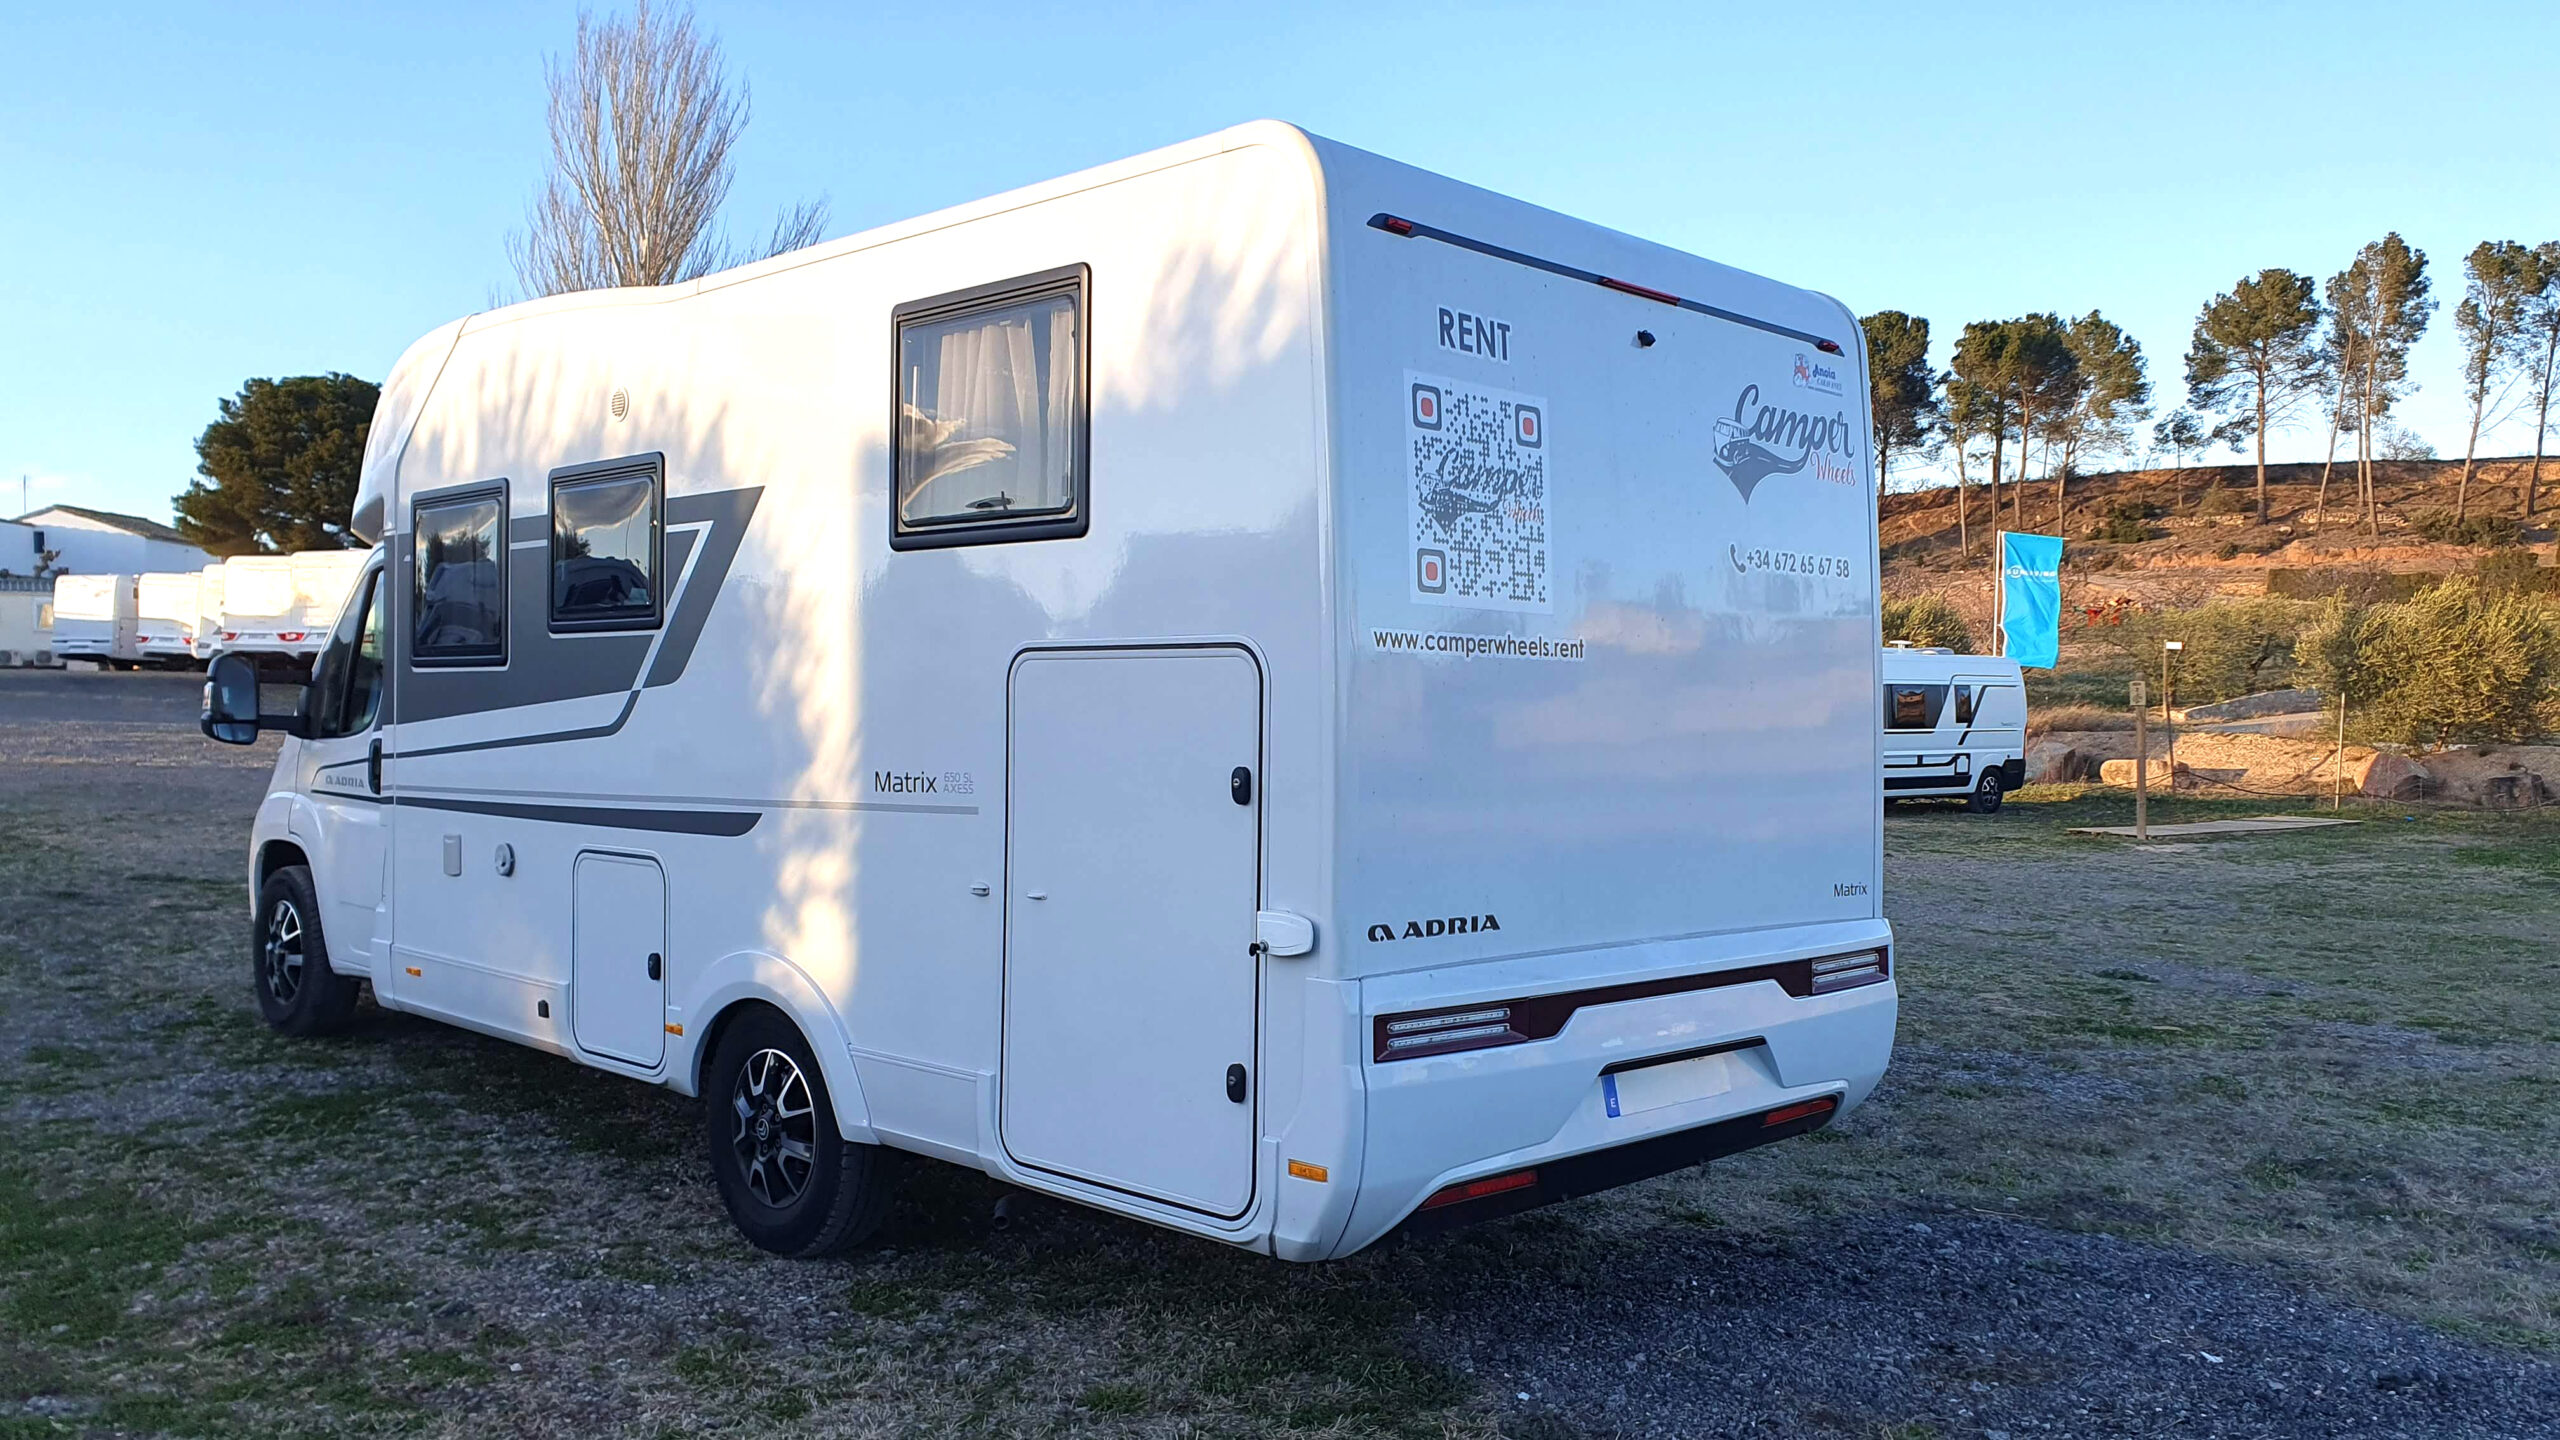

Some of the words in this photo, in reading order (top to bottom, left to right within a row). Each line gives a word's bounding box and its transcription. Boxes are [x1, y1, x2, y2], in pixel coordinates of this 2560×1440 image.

[1438, 306, 1511, 361] RENT
[1735, 384, 1855, 460] Camper
[1810, 451, 1856, 487] Wheels
[1747, 549, 1770, 570] +34
[1774, 552, 1797, 573] 672
[1800, 555, 1815, 574] 65
[1818, 557, 1832, 576] 67
[1836, 559, 1850, 578] 58
[1373, 630, 1585, 658] www.camperwheels.rent
[334, 775, 365, 789] ADRIA
[874, 770, 938, 794] Matrix
[943, 771, 961, 784] 650
[963, 772, 974, 784] SL
[943, 783, 974, 795] AXESS
[1833, 881, 1868, 898] Matrix
[1402, 914, 1501, 940] ADRIA
[1609, 1097, 1617, 1109] E
